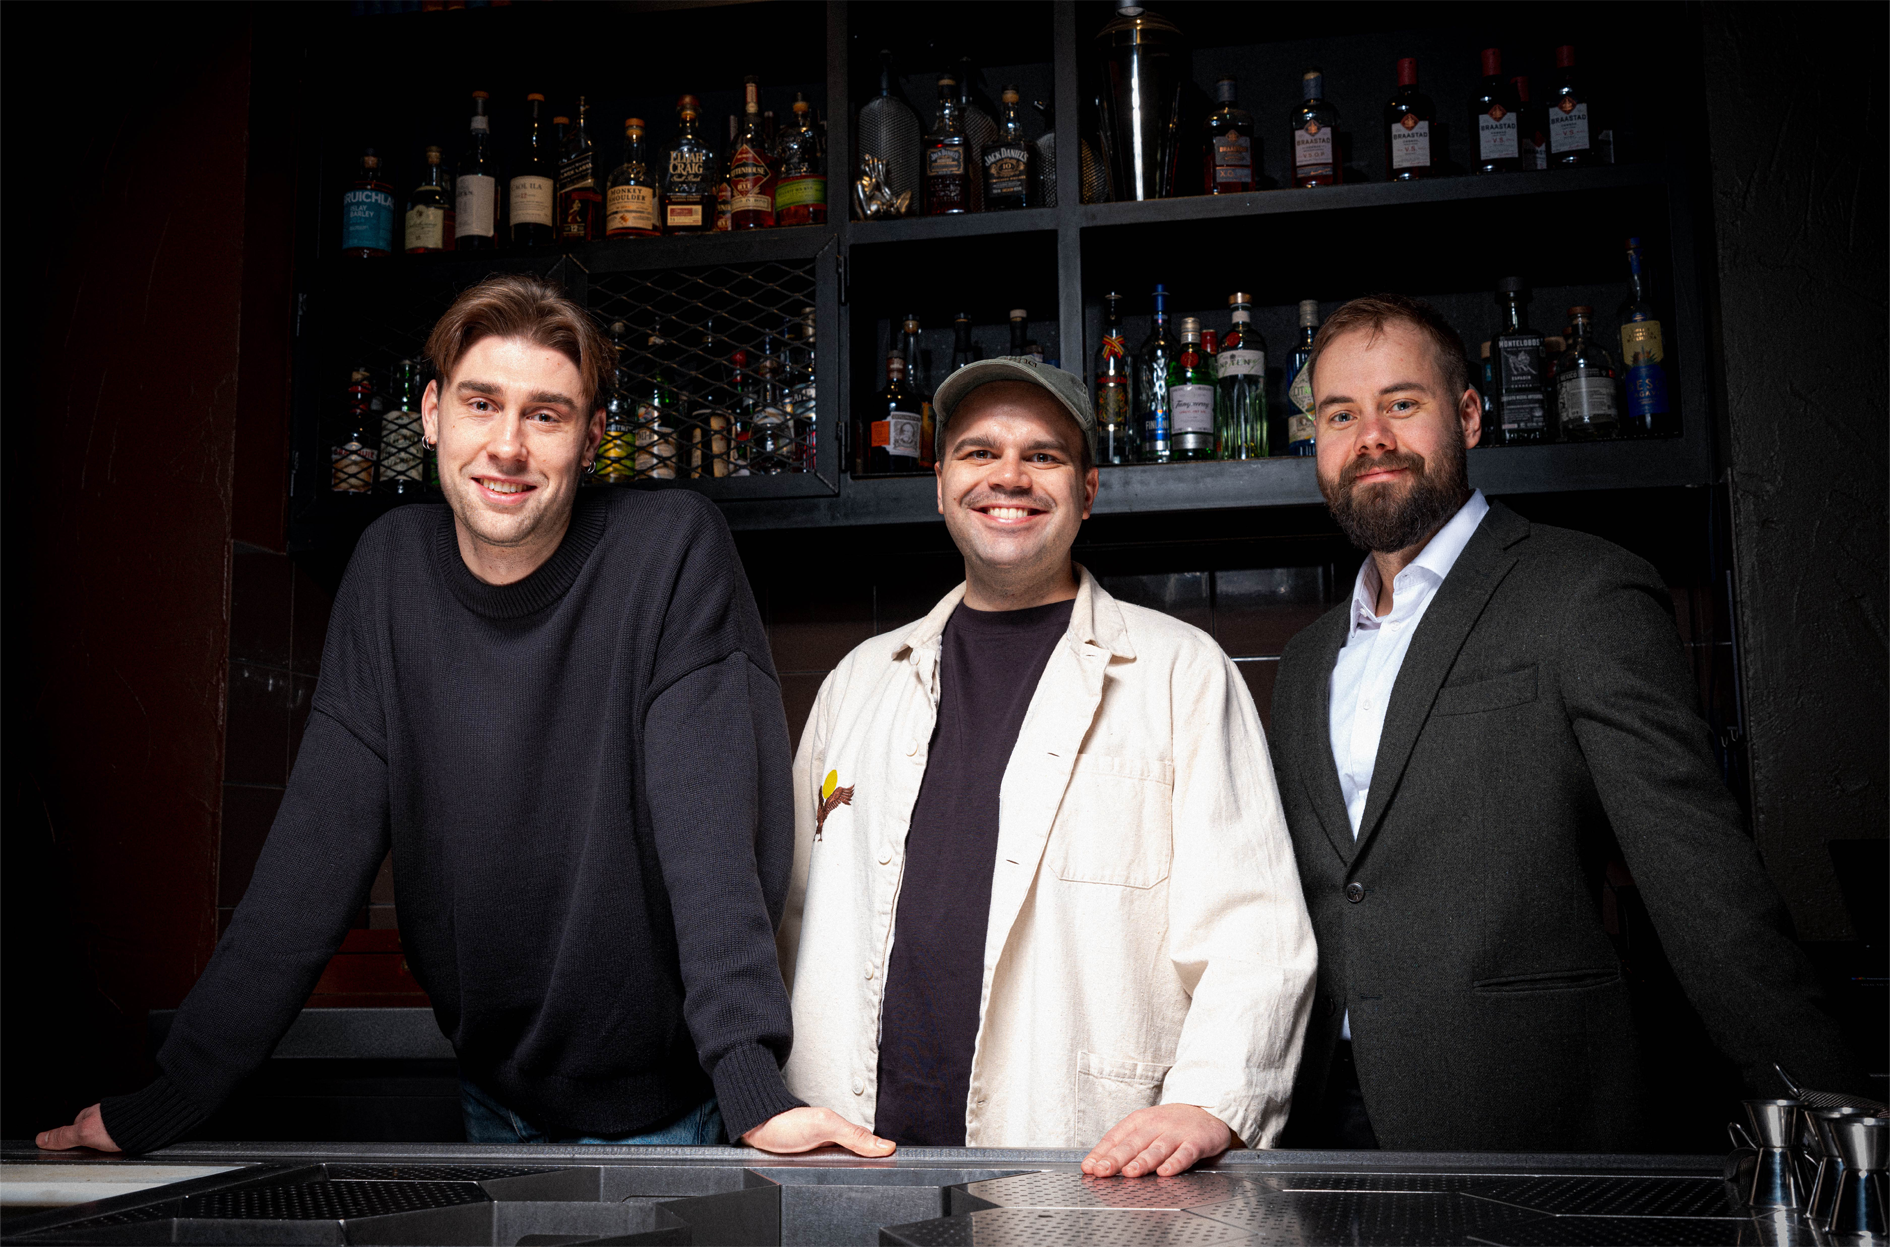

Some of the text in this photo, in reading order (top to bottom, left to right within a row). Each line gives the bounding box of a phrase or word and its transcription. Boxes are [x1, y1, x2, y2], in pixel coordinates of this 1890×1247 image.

[1551, 114, 1587, 124] BRAASTAD
[1481, 123, 1516, 132] BRAASTAD
[1392, 132, 1426, 141] BRAASTAD
[1297, 137, 1330, 147] BRAASTAD
[669, 151, 704, 163] ELIJAH
[985, 147, 1029, 167] JACK DANIEL'S
[669, 163, 703, 174] CRAIG
[343, 190, 395, 210] RUICHLA
[610, 197, 646, 205] SHOULDER
[1498, 338, 1540, 348] MONTELOBOS
[1145, 420, 1169, 431] FINLAN
